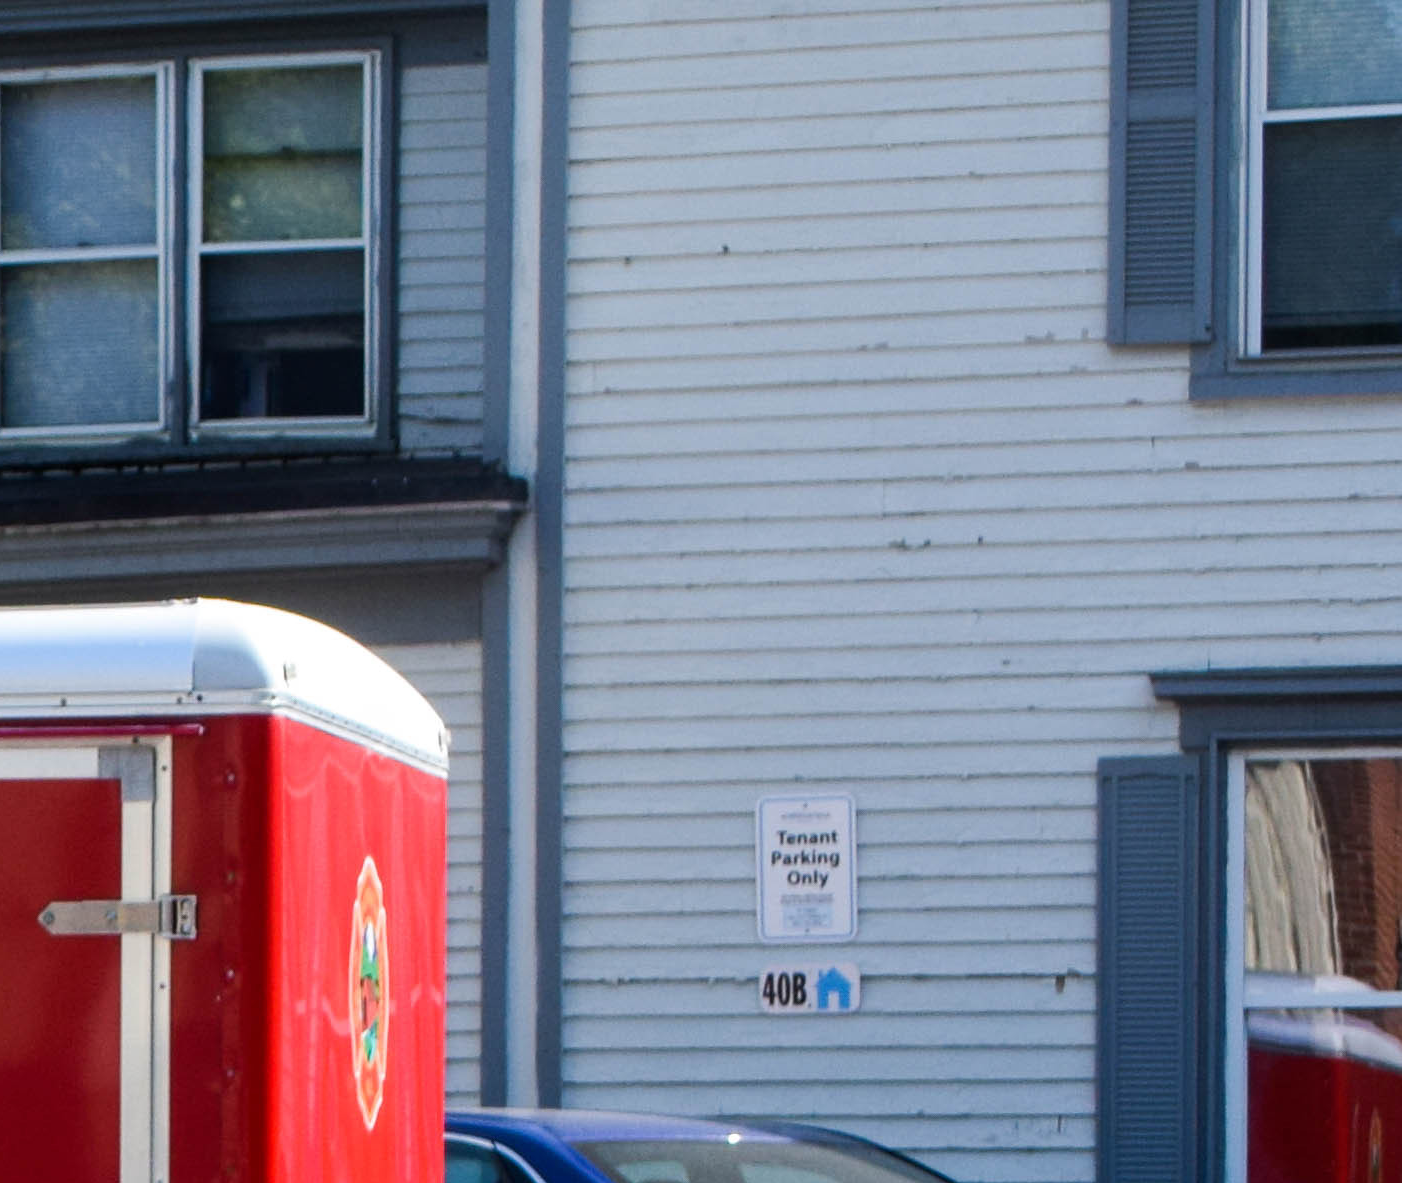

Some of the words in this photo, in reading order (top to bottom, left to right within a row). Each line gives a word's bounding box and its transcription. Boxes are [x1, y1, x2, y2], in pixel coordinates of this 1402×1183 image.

[777, 830, 838, 845] Tenant
[771, 851, 840, 867] Parking
[787, 870, 829, 888] Only
[763, 972, 808, 1006] 40B
